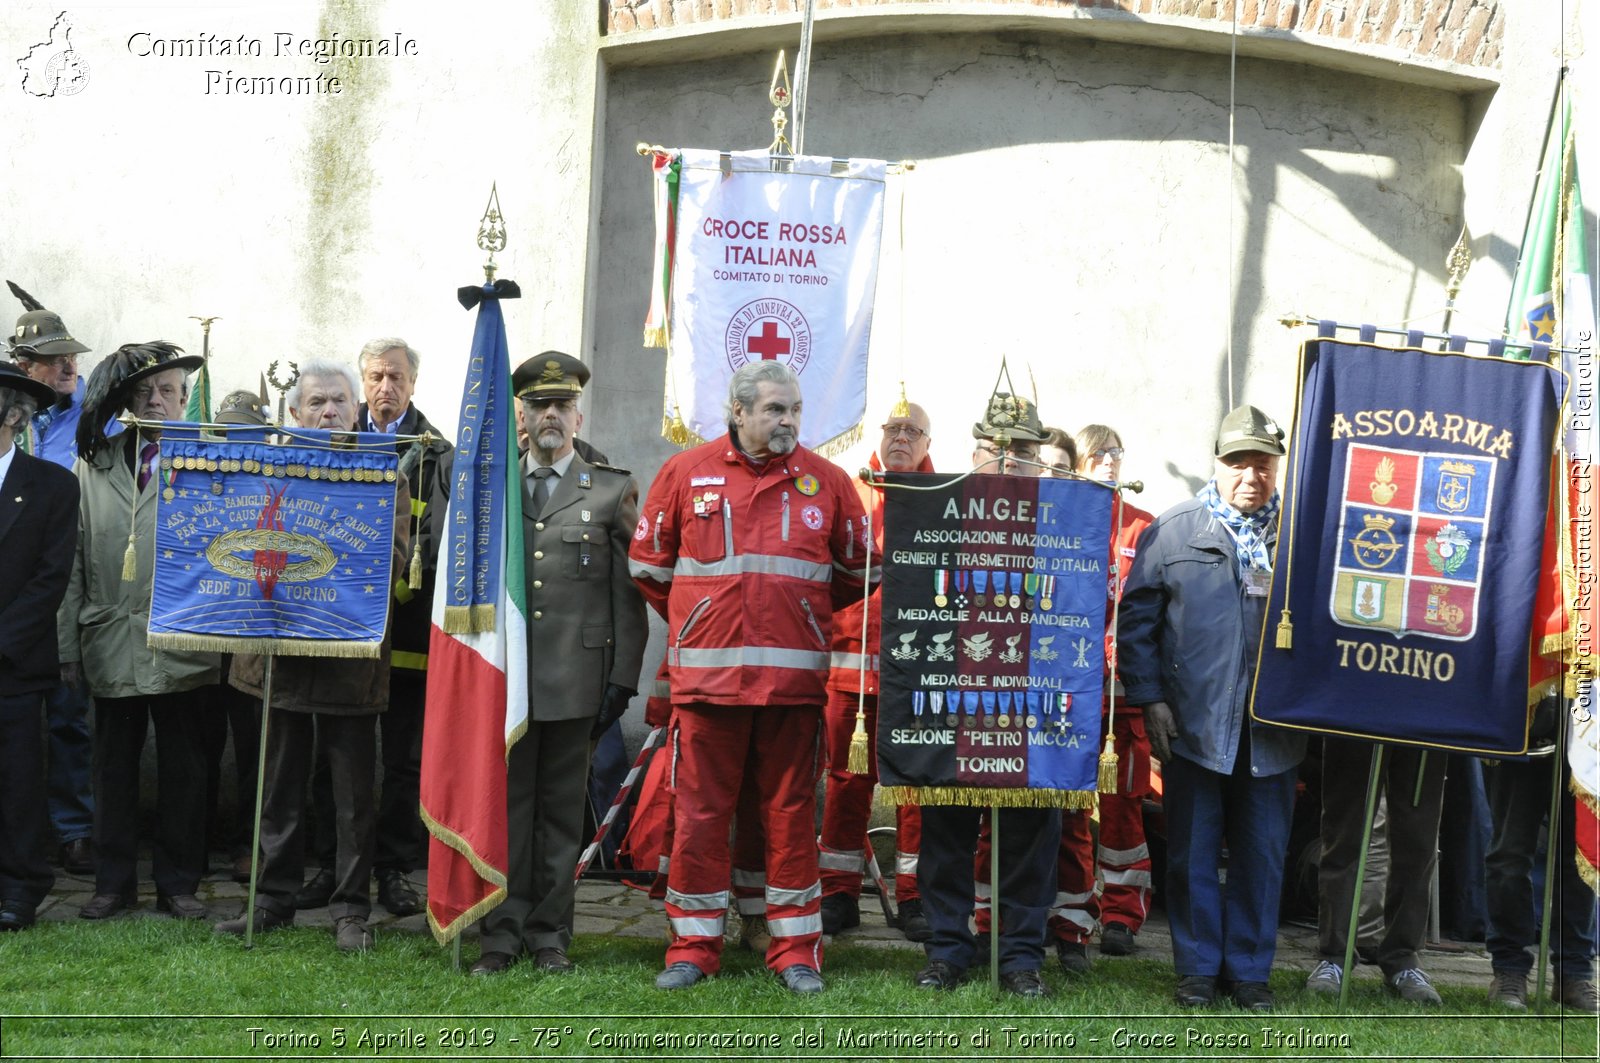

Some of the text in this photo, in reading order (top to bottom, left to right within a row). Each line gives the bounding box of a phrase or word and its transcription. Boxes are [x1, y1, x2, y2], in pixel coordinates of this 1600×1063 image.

[703, 217, 847, 245] CROCE ROSSA
[725, 246, 817, 268] ITALIANA
[713, 270, 828, 286] COMITATO DI TORINO
[742, 308, 755, 321] DI
[756, 302, 793, 320] GINEVRA
[791, 316, 803, 329] 22
[794, 330, 808, 364] AGOSTO
[1331, 409, 1513, 459] ASSOARMA
[479, 452, 494, 484] Pietro
[167, 495, 381, 541] ASS. NAZ. FAMIGLIE MARTIRI E CADUTI
[456, 509, 467, 524] di
[943, 497, 1057, 525] A.N.G.E.T.
[175, 509, 368, 553] PER LA CAUSA DI LIBERAZIONE
[477, 490, 493, 555] FERREIRA
[914, 530, 1082, 549] ASSOCIAZIONE NAZIONALE
[454, 533, 467, 602] TORINO
[892, 551, 1100, 573] GENIERI E TRASMETTITORI D'ITALIA
[198, 580, 337, 602] SEDE DI TORINO
[897, 608, 1090, 628] MEDAGLIE ALLA BANDIERA
[1336, 639, 1456, 682] TORINO
[920, 674, 1062, 689] MEDAGLIE INDIVIDUALI
[891, 729, 956, 745] SEZIONE
[963, 730, 1022, 746] "PIETRO
[956, 756, 1024, 773] TORINO
